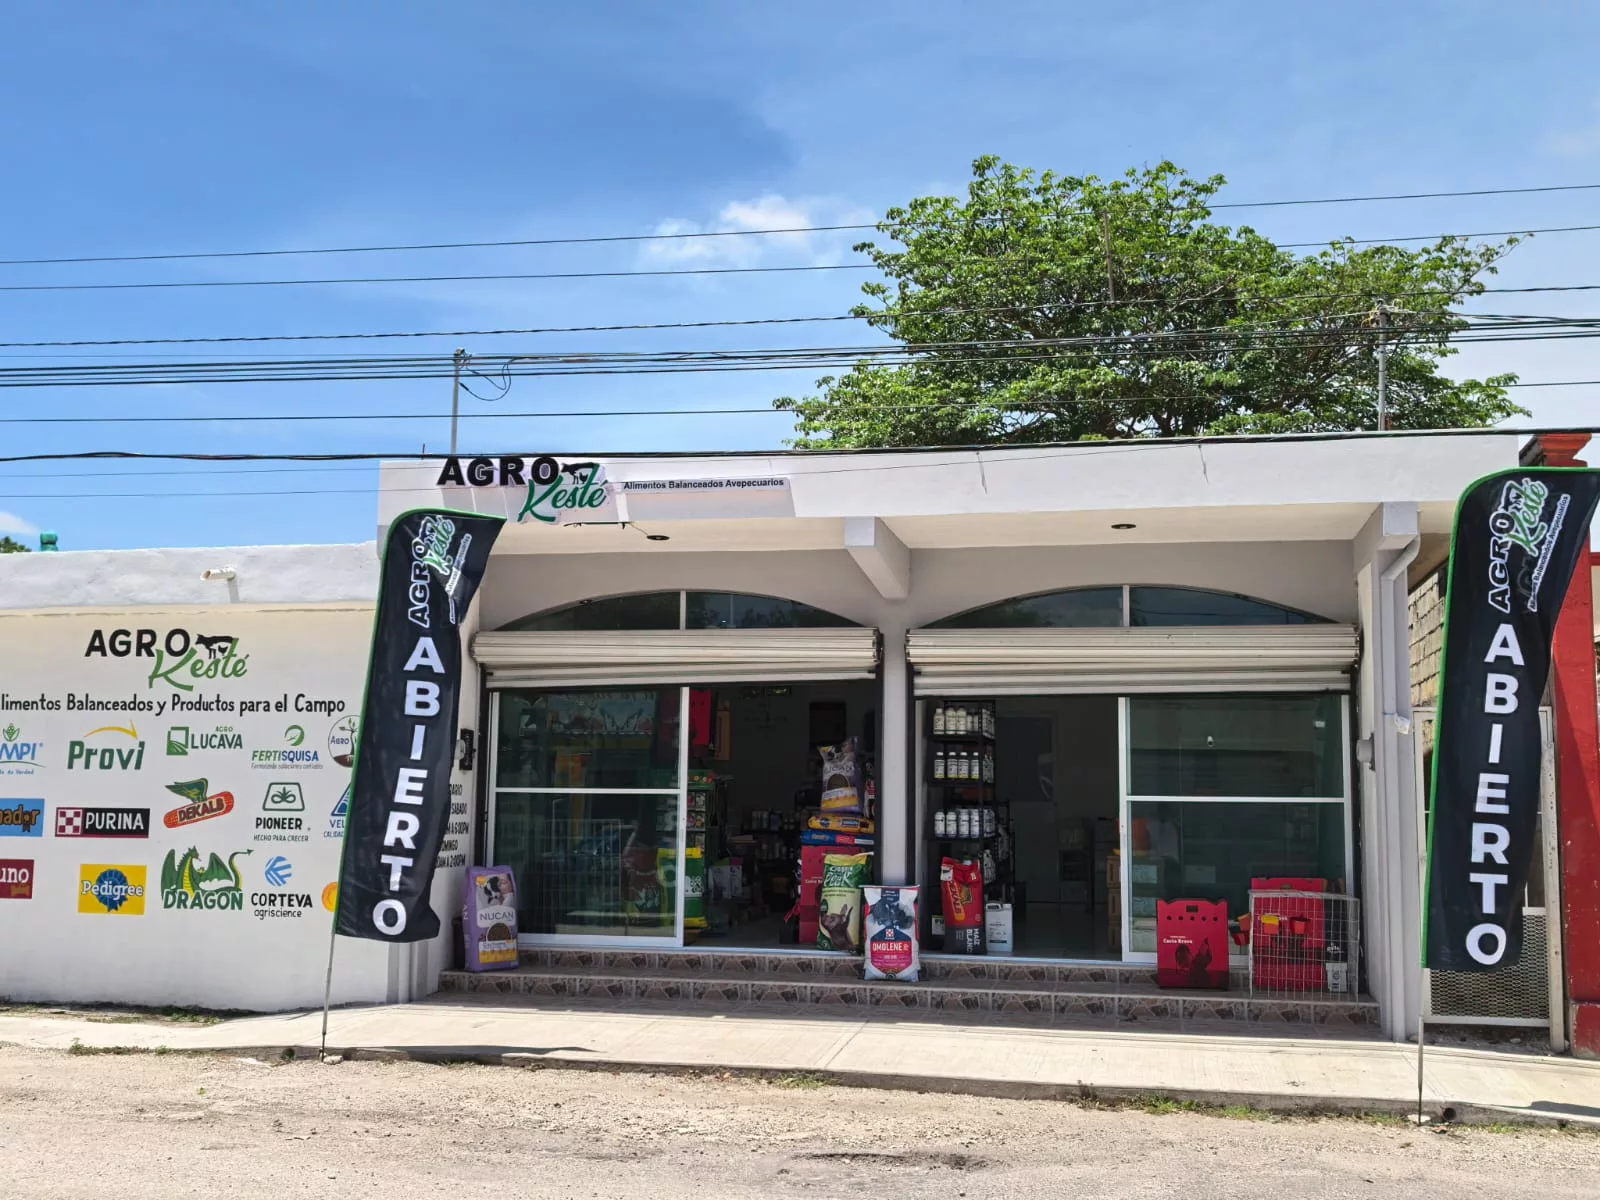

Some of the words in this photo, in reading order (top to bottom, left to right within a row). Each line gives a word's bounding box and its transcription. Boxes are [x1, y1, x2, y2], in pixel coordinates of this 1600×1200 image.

[436, 456, 560, 487] AGRO
[517, 462, 609, 523] Kesté
[623, 481, 666, 490] Alimentos
[668, 480, 723, 489] Balanceados
[725, 478, 784, 489] Avepecuarios
[1488, 508, 1517, 615] AGRO
[408, 537, 431, 629] AGRO
[84, 628, 191, 658] AGRO
[148, 637, 250, 692] Kesté
[1, 693, 61, 711] limentos
[67, 693, 153, 712] Balanceados
[155, 699, 167, 717] y
[171, 693, 235, 712] Productos
[239, 699, 271, 717] para
[274, 693, 288, 713] el
[294, 693, 346, 717] Campo
[0, 742, 37, 761] MPI
[190, 733, 244, 750] LUCAVA
[67, 740, 146, 770] Provi
[251, 750, 320, 764] FERTISQUISA
[371, 636, 446, 937] ABIERTO
[1465, 623, 1525, 967] ABIERTO
[0, 803, 41, 827] ador
[178, 797, 226, 822] DEKALB
[84, 811, 145, 831] PURINA
[255, 816, 304, 830] PIONEER
[328, 818, 345, 829] VEL
[253, 834, 272, 842] HECHO
[273, 834, 287, 842] PARA
[440, 838, 459, 852] OMINGO
[0, 867, 30, 884] uno
[81, 880, 144, 901] Pedigree
[163, 889, 244, 910] DRAGON
[250, 892, 314, 909] CORTEVA
[253, 908, 303, 920] agriscience
[479, 910, 515, 921] NUCAN
[872, 942, 903, 952] OMOLENE
